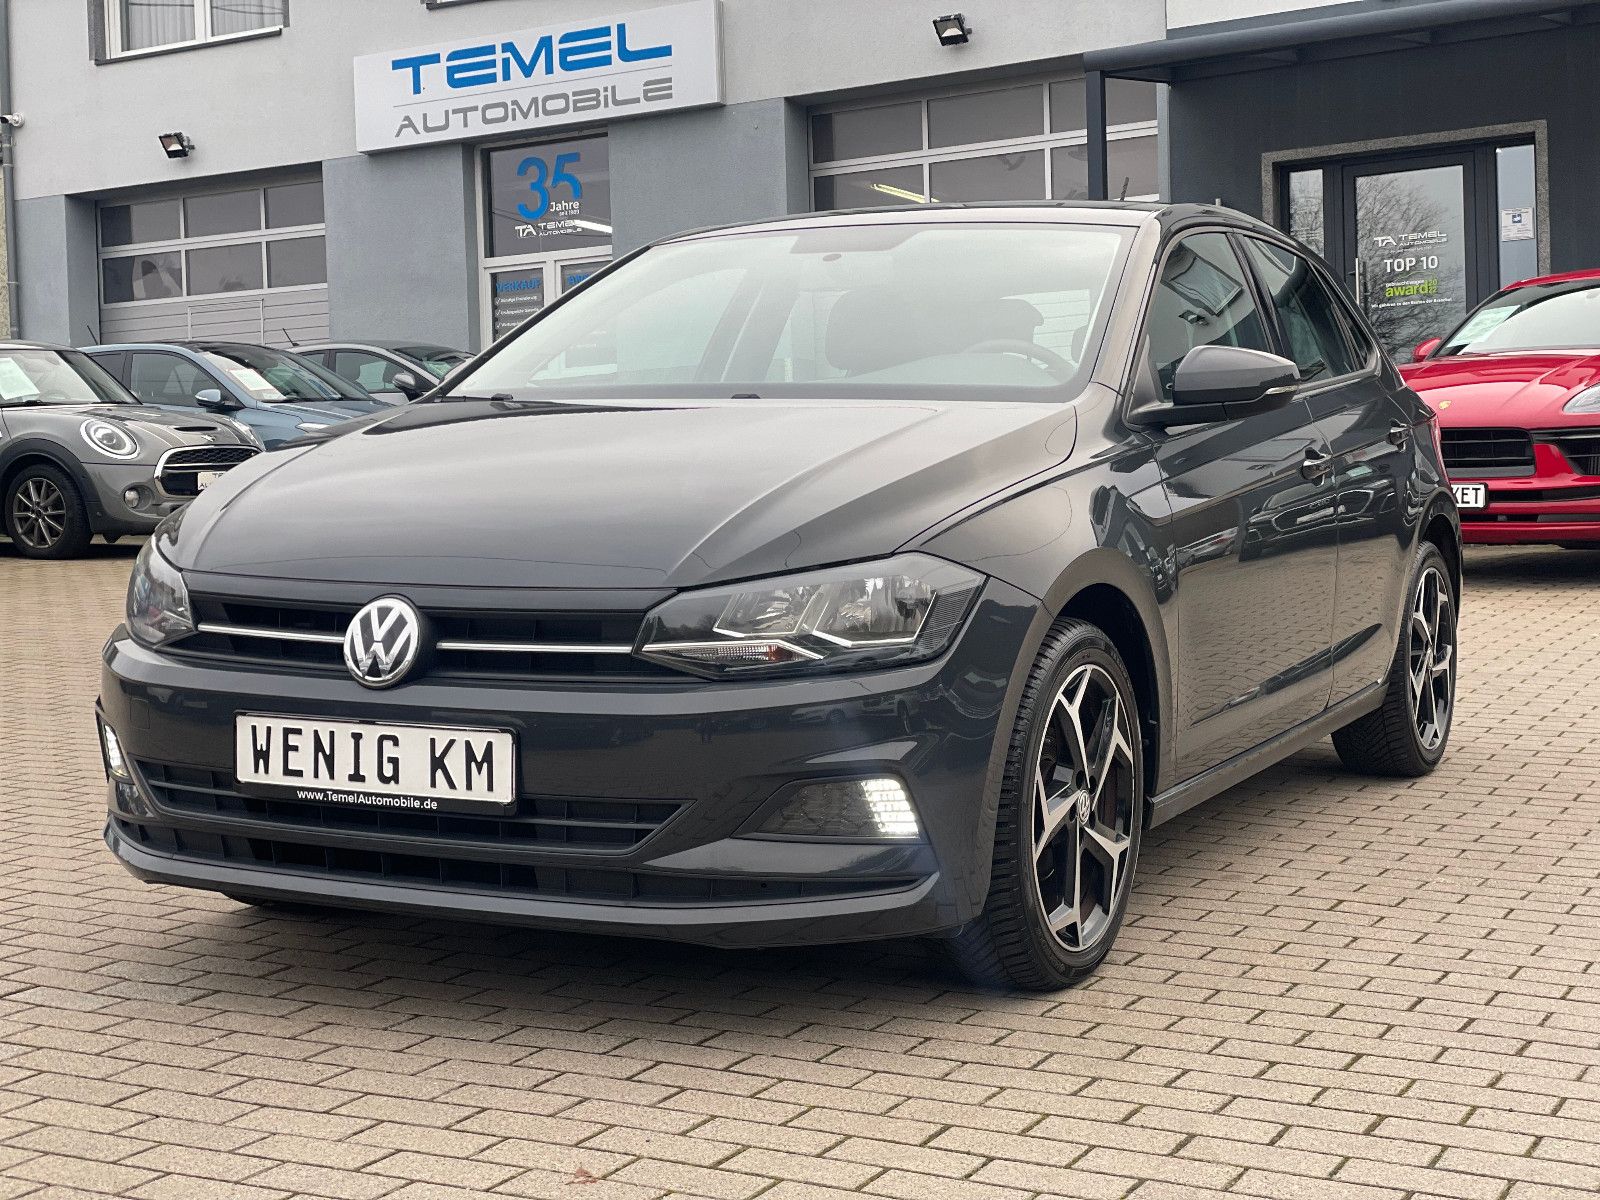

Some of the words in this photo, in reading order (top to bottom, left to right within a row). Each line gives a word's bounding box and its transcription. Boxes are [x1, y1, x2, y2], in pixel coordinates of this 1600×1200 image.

[391, 22, 672, 95] TEMEL
[516, 152, 583, 221] 35
[549, 200, 580, 212] Jahre
[1399, 230, 1447, 240] TEMEL
[1384, 257, 1416, 273] TOP
[1420, 255, 1439, 270] 10
[496, 277, 542, 293] VERKAUF
[1385, 279, 1429, 297] award
[251, 724, 401, 785] WENIG
[430, 737, 494, 792] KM
[296, 789, 438, 810] www.TemelAutomobile.de
